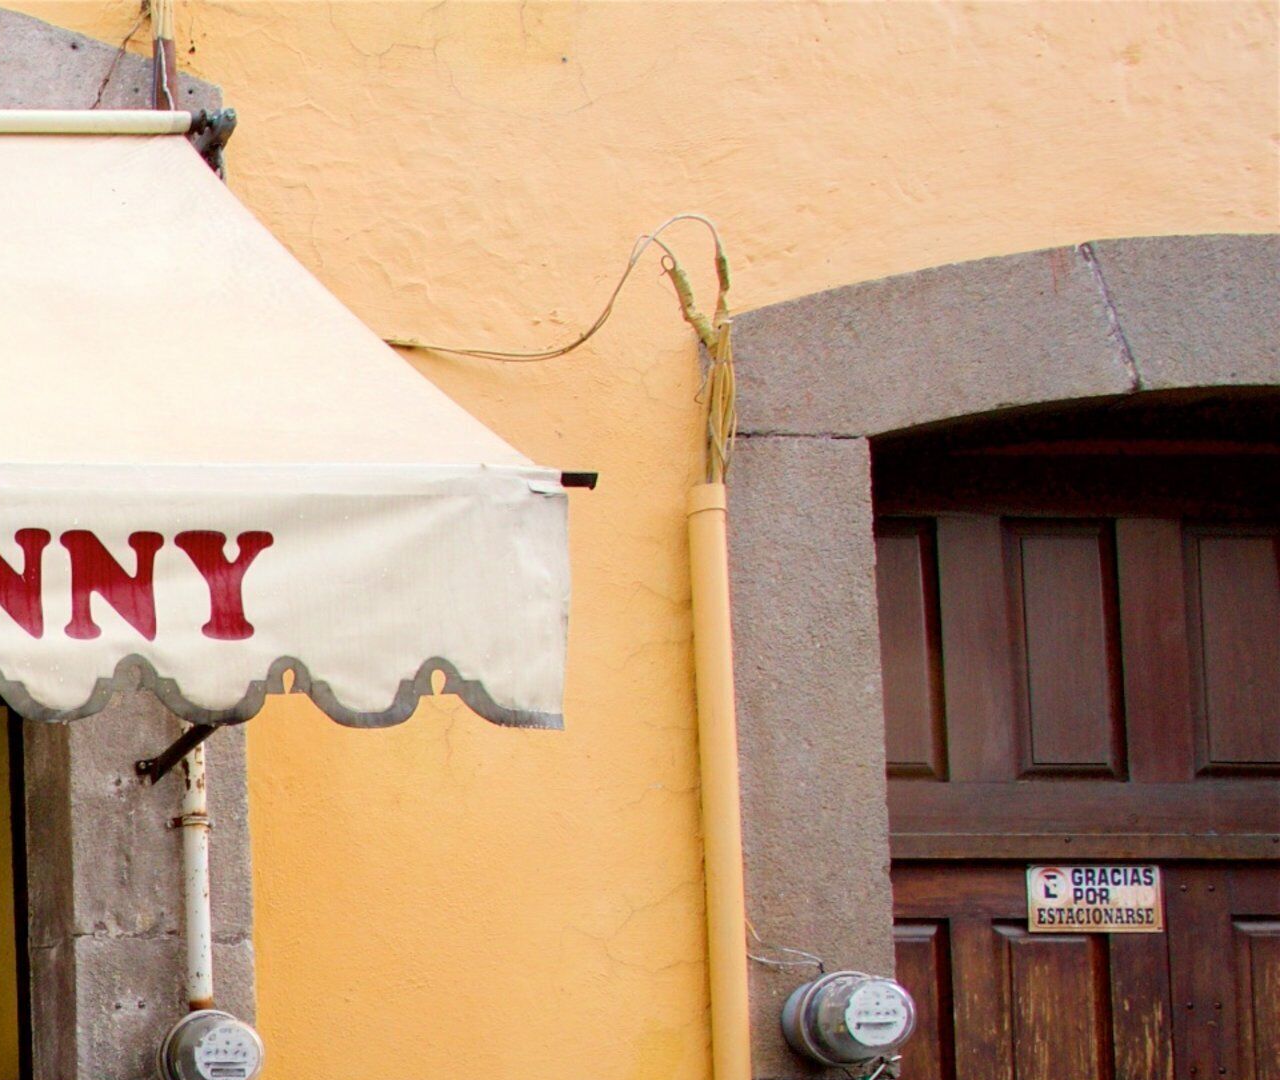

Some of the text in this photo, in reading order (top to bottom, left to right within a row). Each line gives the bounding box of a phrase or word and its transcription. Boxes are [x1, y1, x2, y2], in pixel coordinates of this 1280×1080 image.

[1071, 868, 1154, 886] GRACIAS
[1072, 888, 1110, 904] POR
[1037, 908, 1154, 925] ESTACIONARSE
